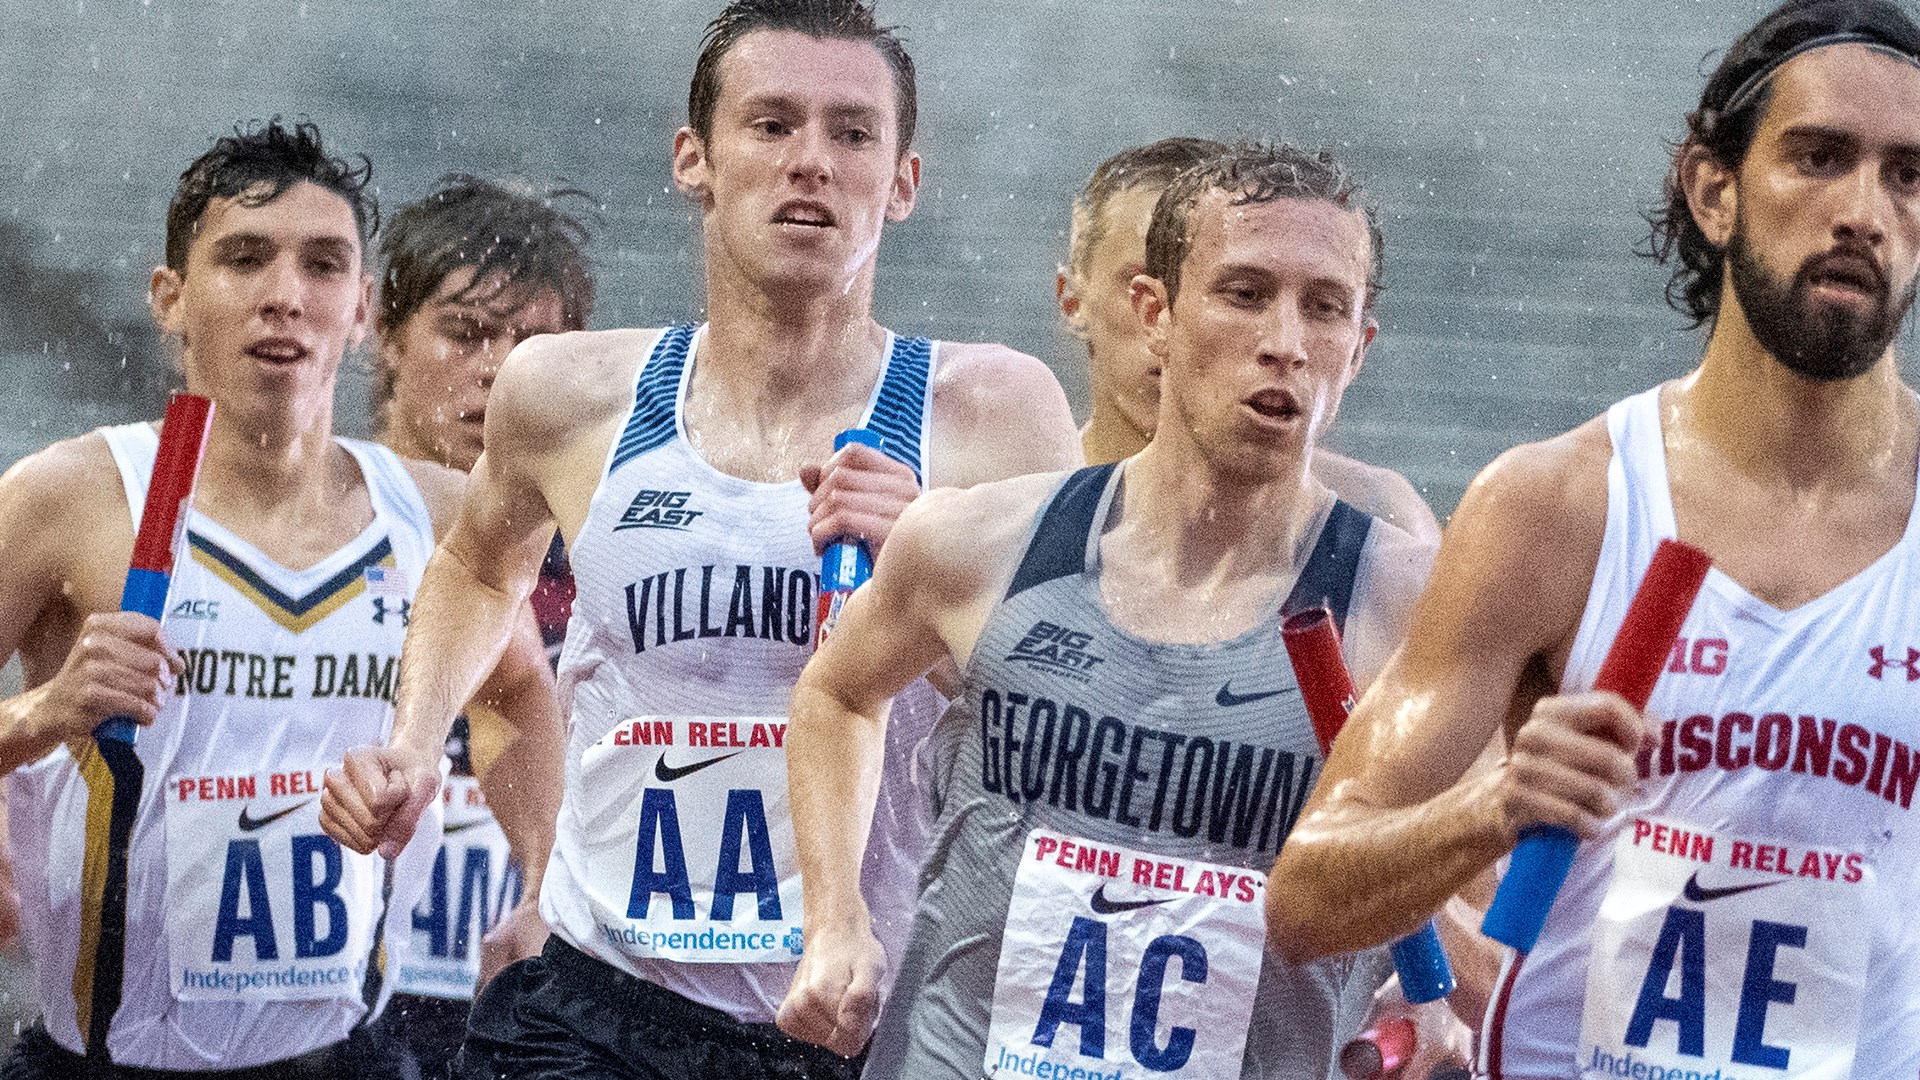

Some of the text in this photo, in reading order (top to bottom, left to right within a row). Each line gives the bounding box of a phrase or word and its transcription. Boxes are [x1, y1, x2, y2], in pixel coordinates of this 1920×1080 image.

[619, 508, 704, 527] EAST
[629, 489, 692, 507] BIG
[172, 599, 220, 619] ACC
[623, 564, 822, 654] VILLANO
[1027, 620, 1094, 649] BIG
[176, 649, 402, 707] NOTRE DAM
[1012, 636, 1105, 670] EAST
[613, 721, 788, 748] ENN RELAY
[1635, 712, 1920, 811] ISCONSIN
[178, 771, 319, 802] PENN REL
[981, 688, 1315, 855] GEORGETOWN
[626, 787, 783, 921] AA
[1035, 836, 1256, 903] PENN RELAYS
[1633, 818, 1864, 884] PENN RELAYS
[211, 834, 349, 963] AB
[602, 923, 776, 951] Independence
[182, 966, 349, 993] Independence
[1030, 915, 1209, 1073] AC
[1623, 905, 1809, 1071] AE
